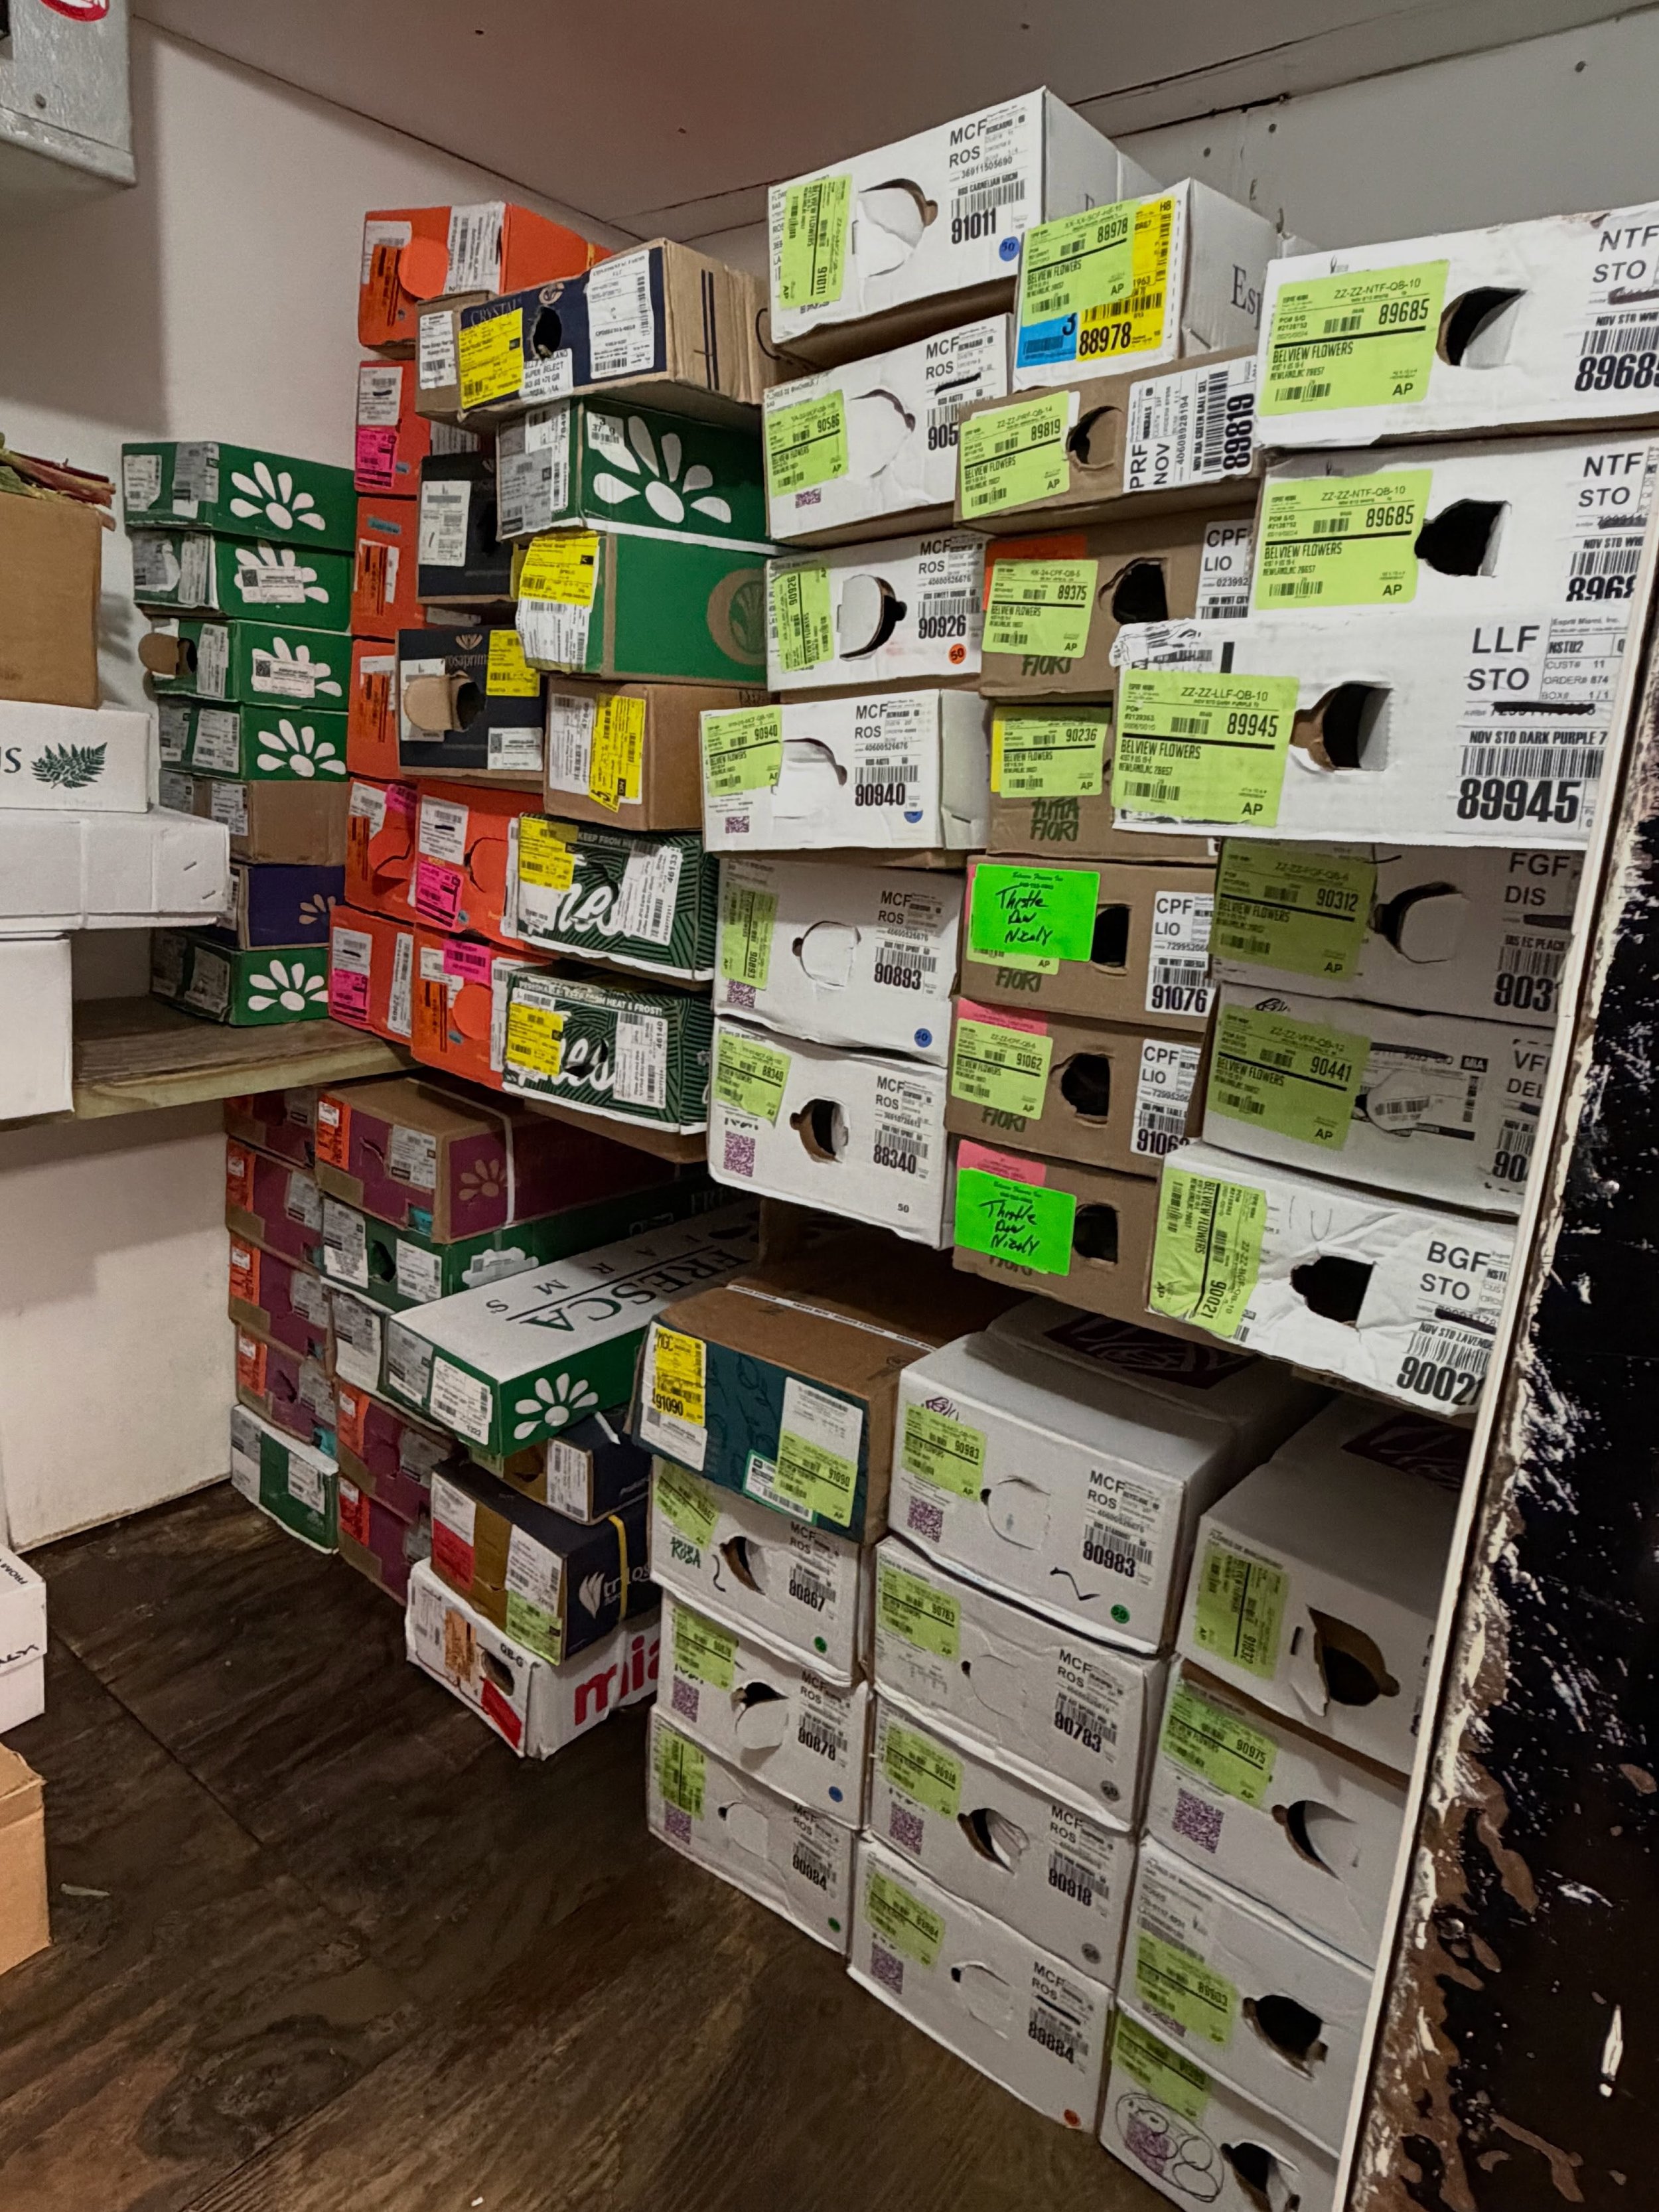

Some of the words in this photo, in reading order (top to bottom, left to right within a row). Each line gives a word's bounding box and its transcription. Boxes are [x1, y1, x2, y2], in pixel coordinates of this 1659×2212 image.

[950, 119, 987, 147] MCF
[949, 146, 980, 168] ROS
[1160, 200, 1171, 211] HB
[952, 208, 996, 244] 91011
[1098, 217, 1128, 243] 88978
[1599, 224, 1659, 252] NTF
[816, 266, 828, 295] 91011
[1027, 268, 1052, 285] BELVIEW
[1053, 259, 1081, 277] FLOWERS
[1593, 259, 1646, 283] STO
[1111, 283, 1124, 296] AP
[1378, 298, 1430, 325] 89685
[926, 335, 959, 359] MCF
[1079, 321, 1132, 356] 88978
[1273, 344, 1310, 364] BELVIEW
[1312, 341, 1354, 358] FLOWERS
[926, 361, 954, 380] ROS
[1392, 383, 1413, 396] AP
[818, 413, 840, 433] 90586
[1031, 418, 1060, 441] 89819
[1224, 394, 1255, 471] 89819
[964, 462, 988, 477] BELVIEW
[989, 456, 1017, 472] FLOWERS
[1130, 444, 1148, 490] PRF
[1153, 443, 1170, 485] NOV
[1583, 452, 1644, 477] NTF
[1046, 478, 1060, 491] AP
[1321, 486, 1406, 501] ZZ-ZZ-NTF-QB-10
[1579, 486, 1630, 507] STO
[1366, 504, 1415, 528] 89685
[920, 539, 951, 555] MCF
[1206, 528, 1248, 548] CPF
[1265, 545, 1301, 559] BELVIEW
[1303, 542, 1342, 557] FLOWERS
[918, 561, 945, 574] ROS
[1204, 555, 1232, 572] LIO
[1058, 585, 1088, 601] 89375
[1382, 584, 1402, 596] AP
[1015, 607, 1041, 617] FLOWERS
[918, 615, 967, 639] 90926
[1064, 642, 1077, 652] AP
[1473, 625, 1540, 654] LLF
[950, 647, 965, 660] 50
[1467, 668, 1530, 691] STO
[1181, 687, 1268, 701] ZZ-ZZ-LLF-QB-10
[856, 703, 888, 720] MCF
[754, 723, 778, 741] 90940
[855, 725, 881, 739] ROS
[1066, 727, 1098, 743] 90236
[1227, 713, 1279, 737] 89945
[1469, 731, 1492, 743] NOV
[1495, 731, 1516, 744] STO
[1519, 731, 1550, 745] DARK
[1553, 731, 1596, 745] PURPLE
[1028, 751, 1053, 761] FLOWERS
[1121, 739, 1158, 756] BELVIEW
[1159, 743, 1202, 759] FLOWERS
[855, 782, 906, 806] 90940
[1080, 781, 1093, 791] AP
[1241, 802, 1263, 816] AP
[1457, 778, 1582, 824] 89945
[579, 832, 598, 843] KEEP
[599, 836, 620, 846] FROM
[1031, 820, 1079, 842] FIORI
[1508, 851, 1571, 877] FGF
[881, 891, 912, 908] MCF
[1156, 898, 1194, 915] CPF
[1316, 888, 1358, 912] 90312
[1504, 885, 1547, 907] DIS
[878, 911, 904, 924] ROS
[1253, 907, 1290, 922] FLOWERS
[1155, 922, 1181, 936] LIO
[1038, 958, 1050, 968] AP
[1324, 962, 1342, 973] AP
[874, 962, 922, 990] 90893
[607, 997, 626, 1009] HEAT
[634, 1003, 663, 1015] FROST!
[1152, 986, 1208, 1013] 91076
[1015, 1053, 1042, 1070] 91062
[1143, 1046, 1179, 1065] CPF
[1141, 1069, 1167, 1084] LIO
[1217, 1057, 1247, 1076] BELVIEW
[1249, 1066, 1284, 1087] FLOWERS
[1310, 1056, 1352, 1082] 90441
[877, 1076, 904, 1094] MCF
[1507, 1078, 1543, 1098] DEL
[875, 1095, 899, 1110] ROS
[1023, 1103, 1035, 1114] AP
[1315, 1128, 1333, 1140] AP
[873, 1144, 917, 1175] 88340
[897, 1203, 910, 1213] 50
[1195, 1216, 1207, 1254] FLOWERS
[1427, 1240, 1491, 1272] BGF
[1419, 1273, 1470, 1301] STO
[1201, 1280, 1226, 1319] 90021
[1089, 1470, 1125, 1494] MCF
[1088, 1489, 1118, 1510] ROS
[1082, 1541, 1136, 1578] 90983
[1059, 1649, 1092, 1674] MCF
[1057, 1666, 1085, 1688] ROS
[801, 1686, 823, 1705] ROS
[1051, 1805, 1083, 1829] MCF
[1050, 1822, 1077, 1844] ROS
[1031, 1978, 1058, 2000] ROS
